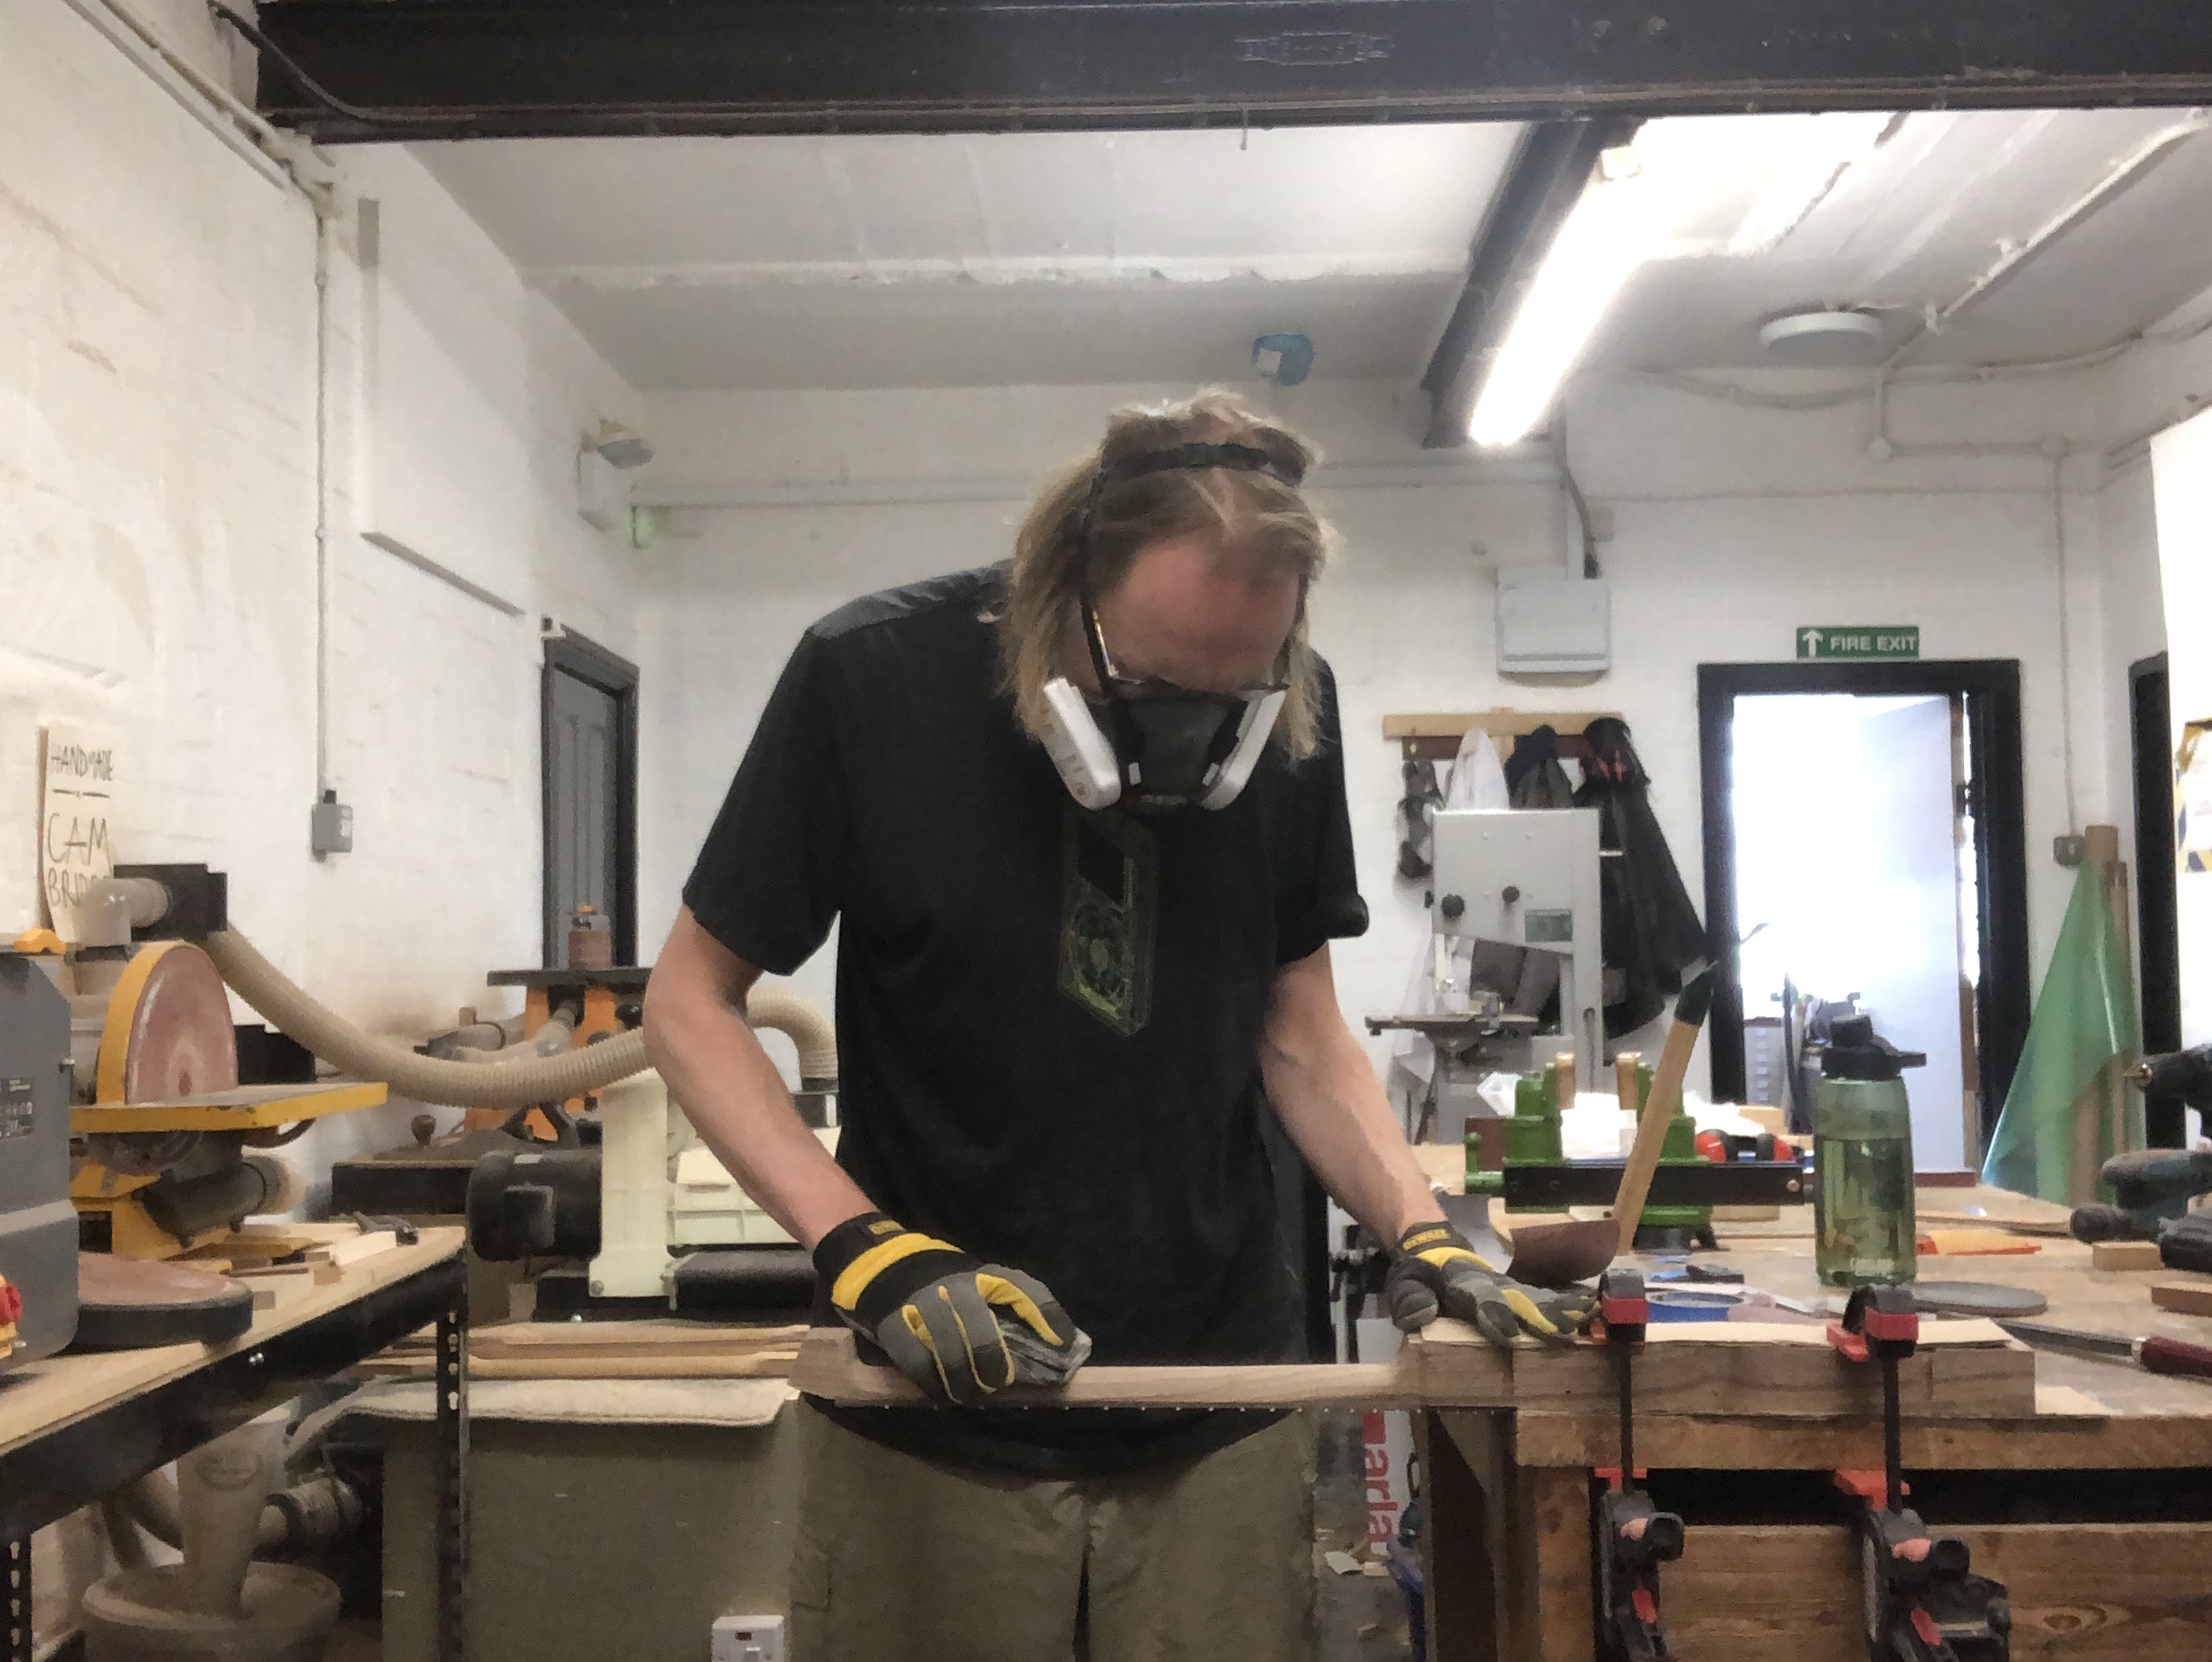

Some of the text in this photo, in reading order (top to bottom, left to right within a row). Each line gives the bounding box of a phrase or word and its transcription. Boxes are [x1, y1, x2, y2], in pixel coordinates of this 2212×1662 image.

[1830, 635, 1916, 651] FIRE EXIT
[48, 813, 113, 876] CAM
[1365, 1449, 1398, 1543] arla
